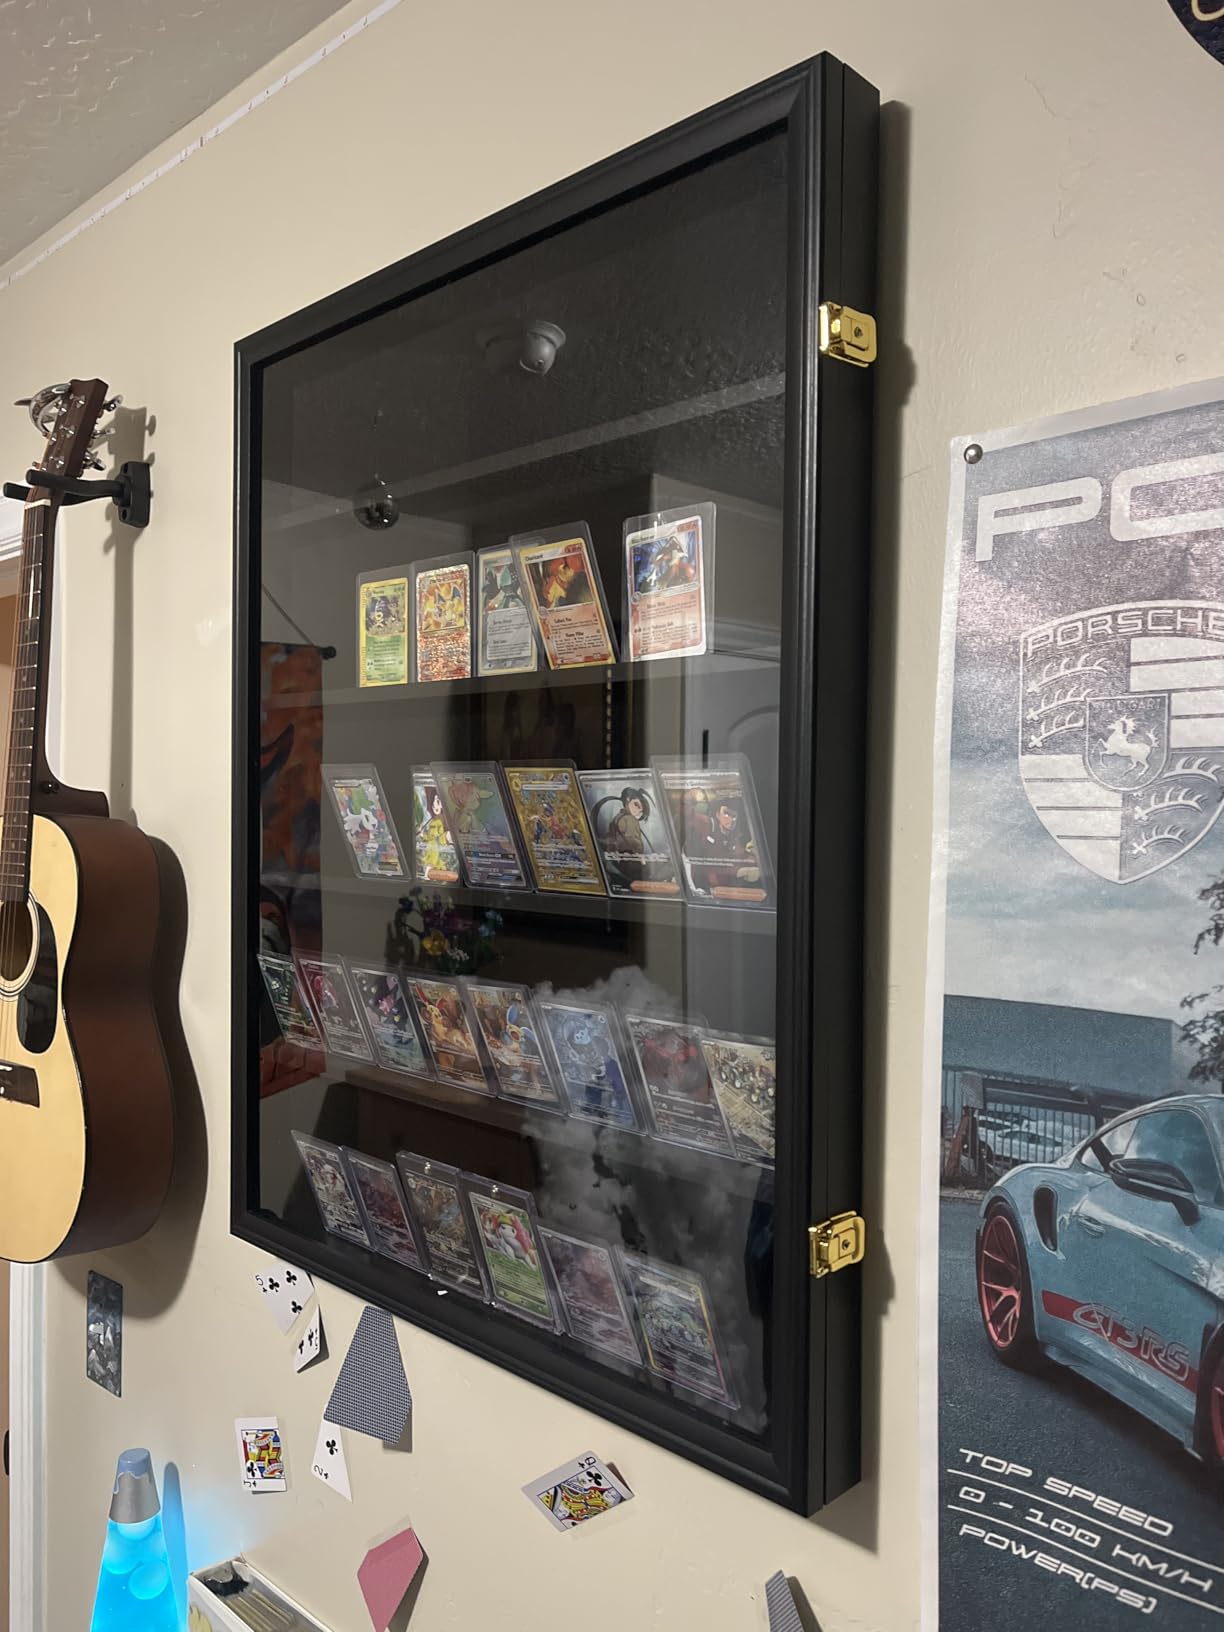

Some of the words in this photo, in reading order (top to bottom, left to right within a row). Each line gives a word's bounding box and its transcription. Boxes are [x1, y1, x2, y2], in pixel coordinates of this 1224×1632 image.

[1026, 608, 1224, 659] PORSCHE
[255, 1274, 264, 1286] 5
[243, 1480, 252, 1488] J
[313, 1464, 324, 1476] 2
[959, 1448, 1033, 1478] TOP
[1043, 1476, 1174, 1536] SPEED
[959, 1486, 985, 1503] 0
[1025, 1507, 1101, 1548] 100
[1112, 1544, 1213, 1592] KM/H
